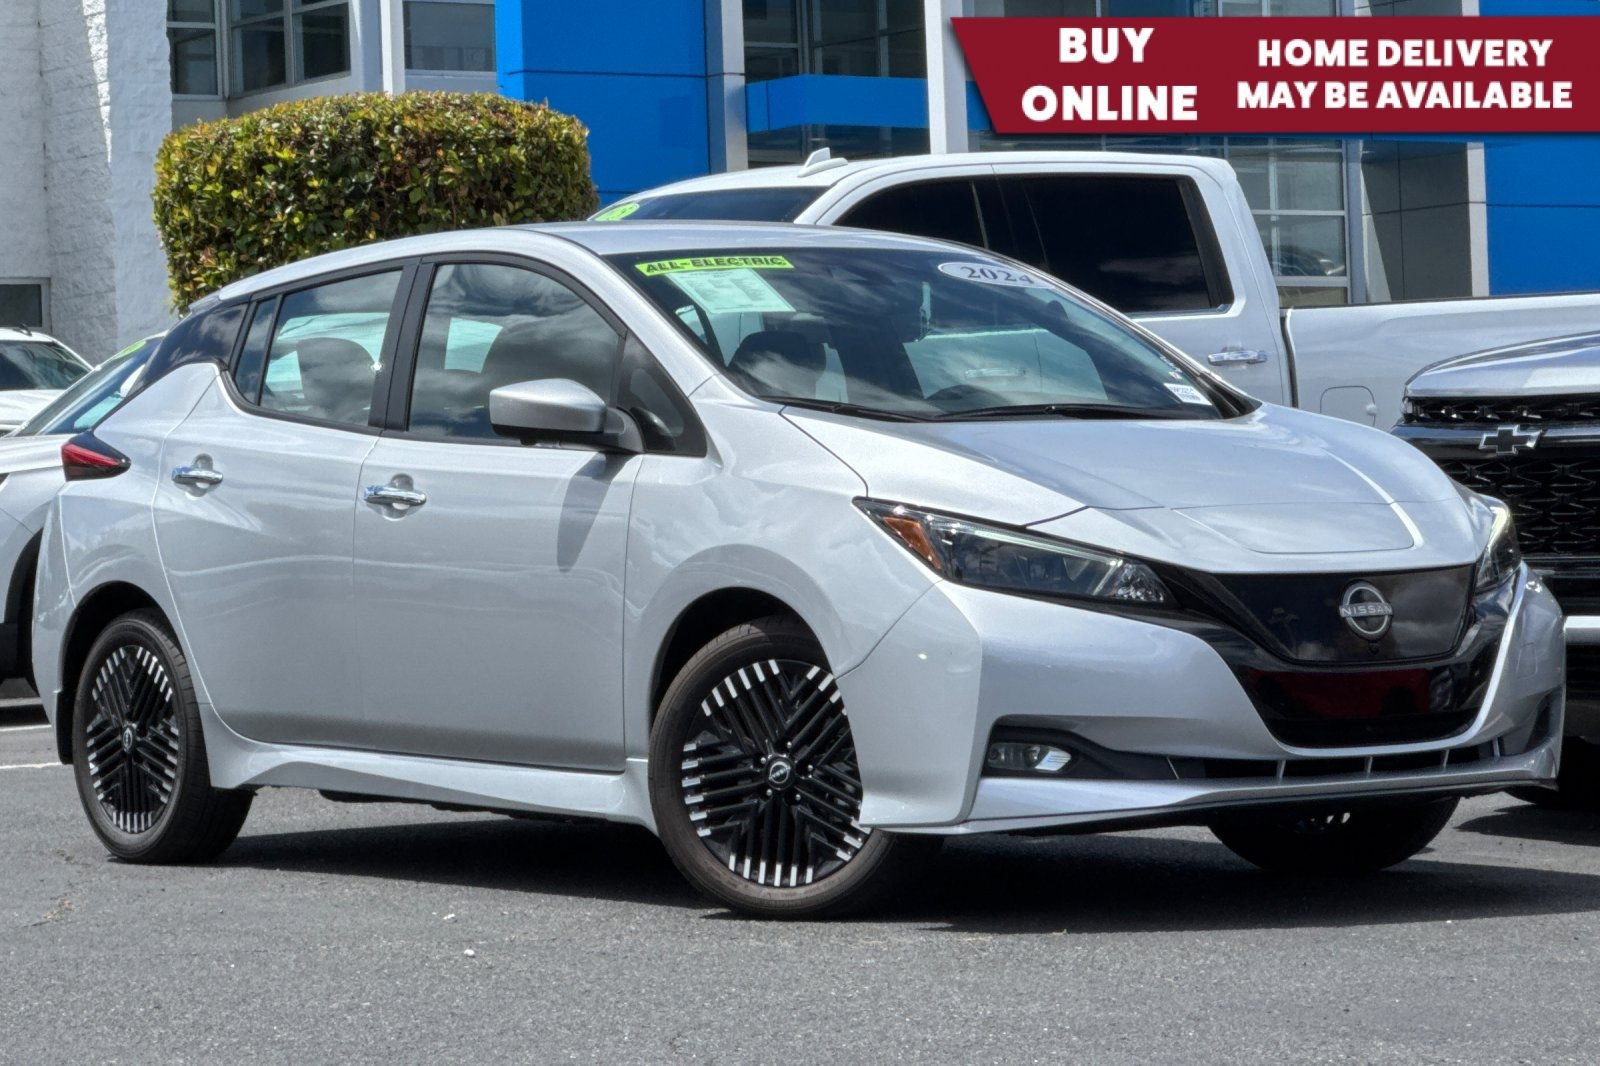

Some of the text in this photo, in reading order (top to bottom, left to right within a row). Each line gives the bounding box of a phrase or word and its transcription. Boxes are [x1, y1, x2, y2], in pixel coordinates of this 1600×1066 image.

[646, 257, 786, 273] ALL-ELECTRIC
[960, 266, 1034, 284] 2024
[1341, 605, 1392, 616] NISSAN
